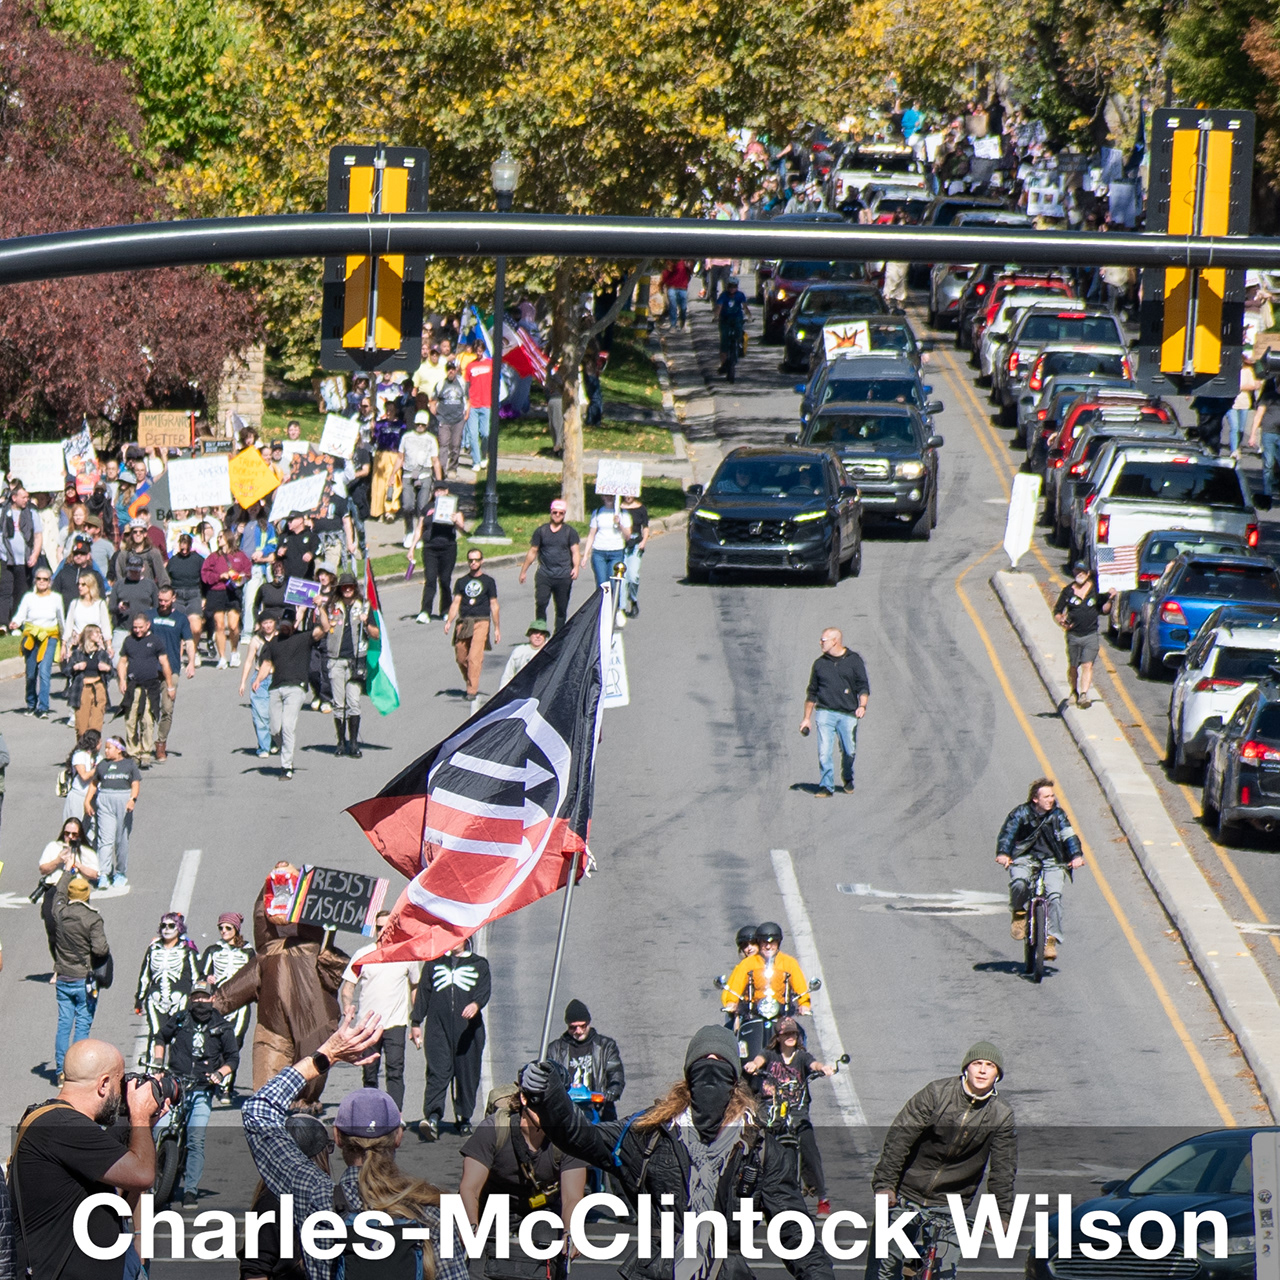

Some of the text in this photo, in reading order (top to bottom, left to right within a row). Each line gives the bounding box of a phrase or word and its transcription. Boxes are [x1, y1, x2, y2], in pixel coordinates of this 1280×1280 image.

[145, 433, 186, 446] BETTER
[311, 868, 378, 898] RESIST
[301, 894, 368, 928] FASCISM
